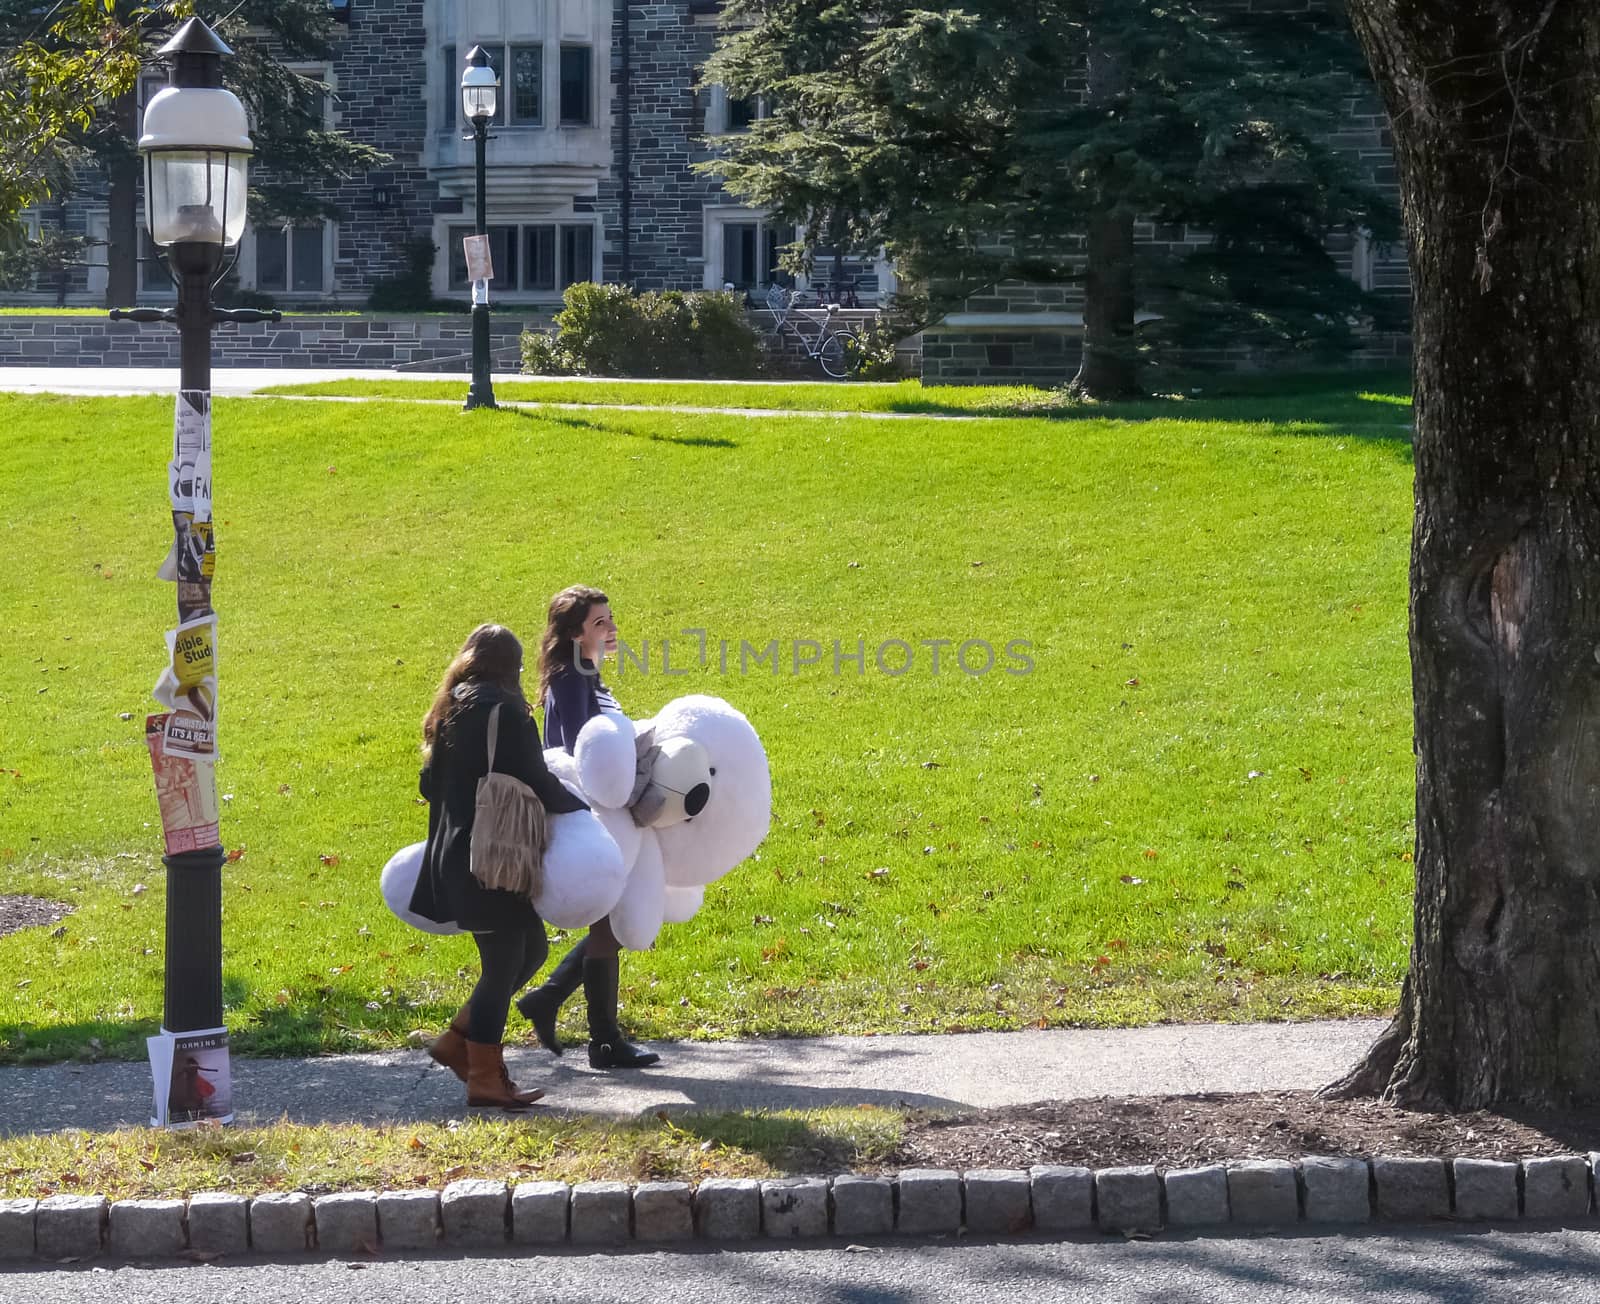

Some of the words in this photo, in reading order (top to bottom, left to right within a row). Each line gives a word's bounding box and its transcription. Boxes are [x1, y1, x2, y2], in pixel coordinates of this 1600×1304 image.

[175, 636, 203, 654] Bible
[171, 727, 186, 739] IT'S
[186, 730, 192, 740] A
